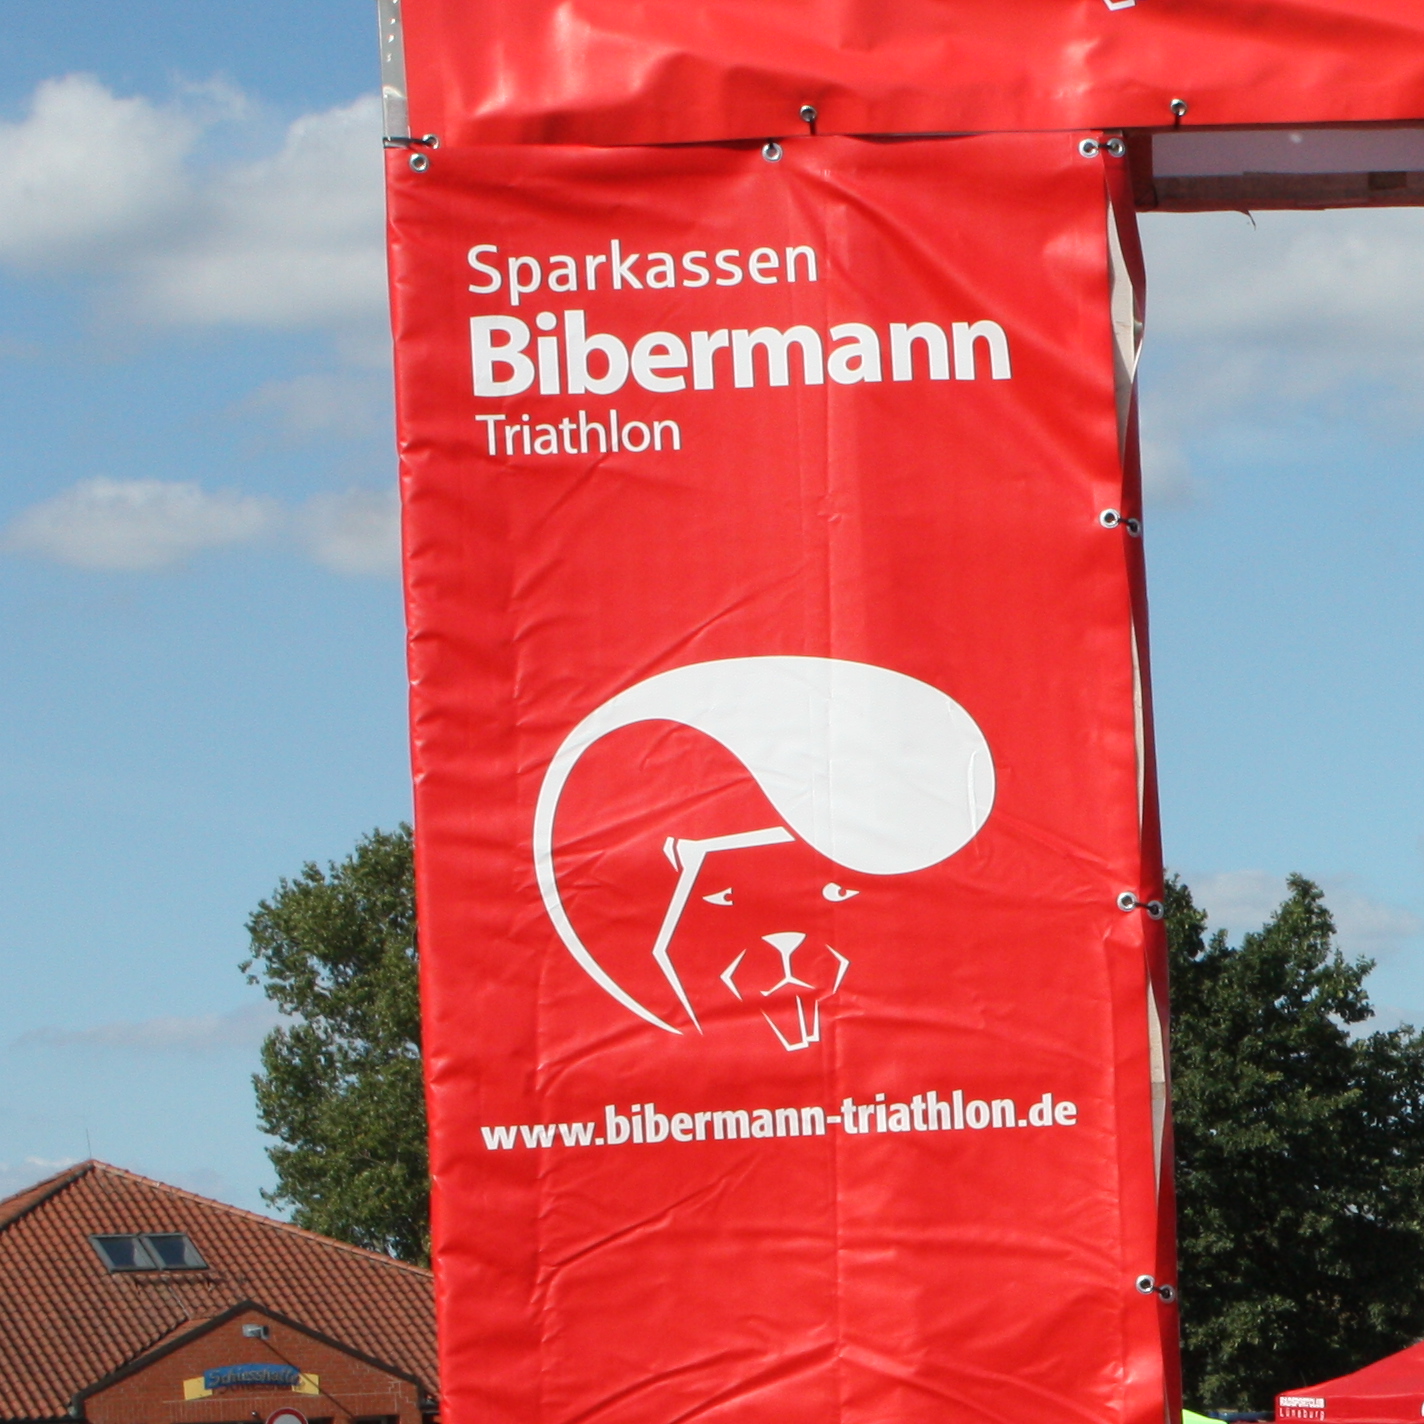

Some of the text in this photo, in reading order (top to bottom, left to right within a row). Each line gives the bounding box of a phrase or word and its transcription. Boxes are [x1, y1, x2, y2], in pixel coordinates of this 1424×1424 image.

[466, 240, 818, 306] Sparkassen
[468, 310, 1012, 398] Bibermann
[475, 410, 682, 457] Triathlon
[481, 1089, 1077, 1150] www.bibermann-triathlon.de
